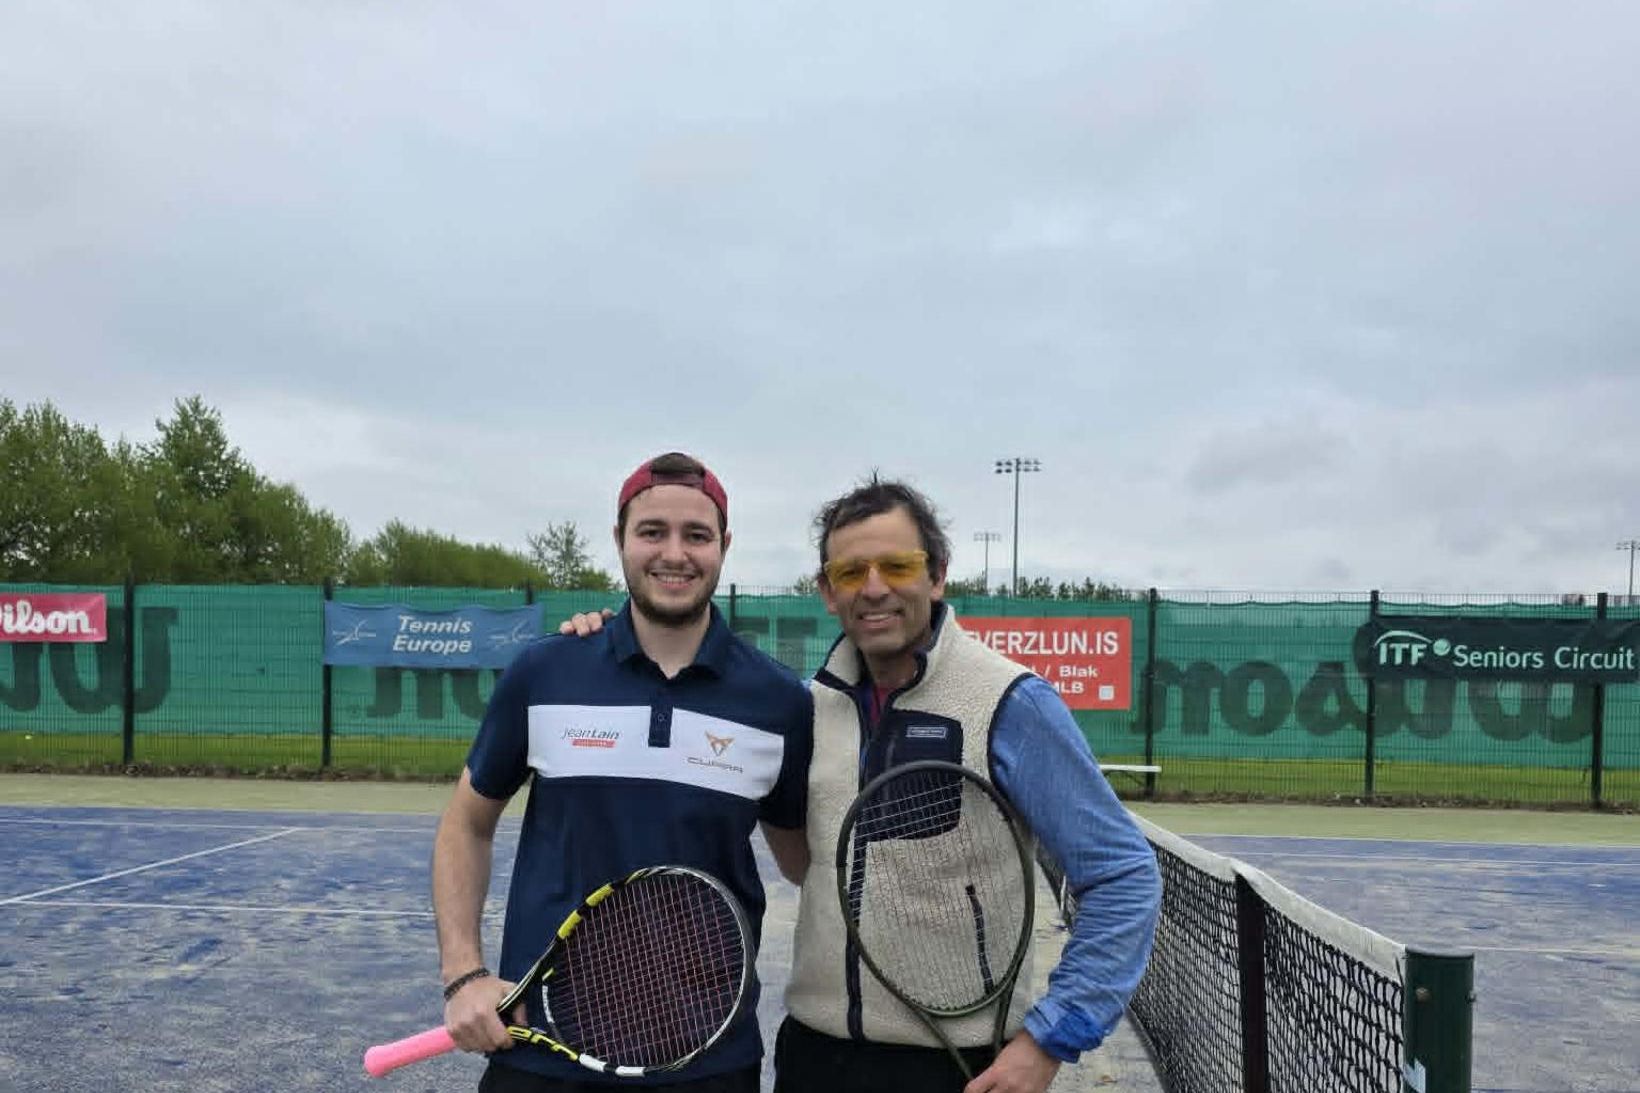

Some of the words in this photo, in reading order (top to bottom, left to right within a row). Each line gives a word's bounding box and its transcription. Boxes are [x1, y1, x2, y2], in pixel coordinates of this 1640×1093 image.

[0, 600, 97, 634] ilson
[399, 615, 472, 634] Tennis
[393, 634, 472, 656] Europe
[967, 631, 1119, 655] VERZLUN.IS
[1379, 643, 1428, 665] ITF
[1453, 645, 1544, 669] Seniors
[1555, 647, 1634, 670] Circuit
[1059, 664, 1099, 678] Blak
